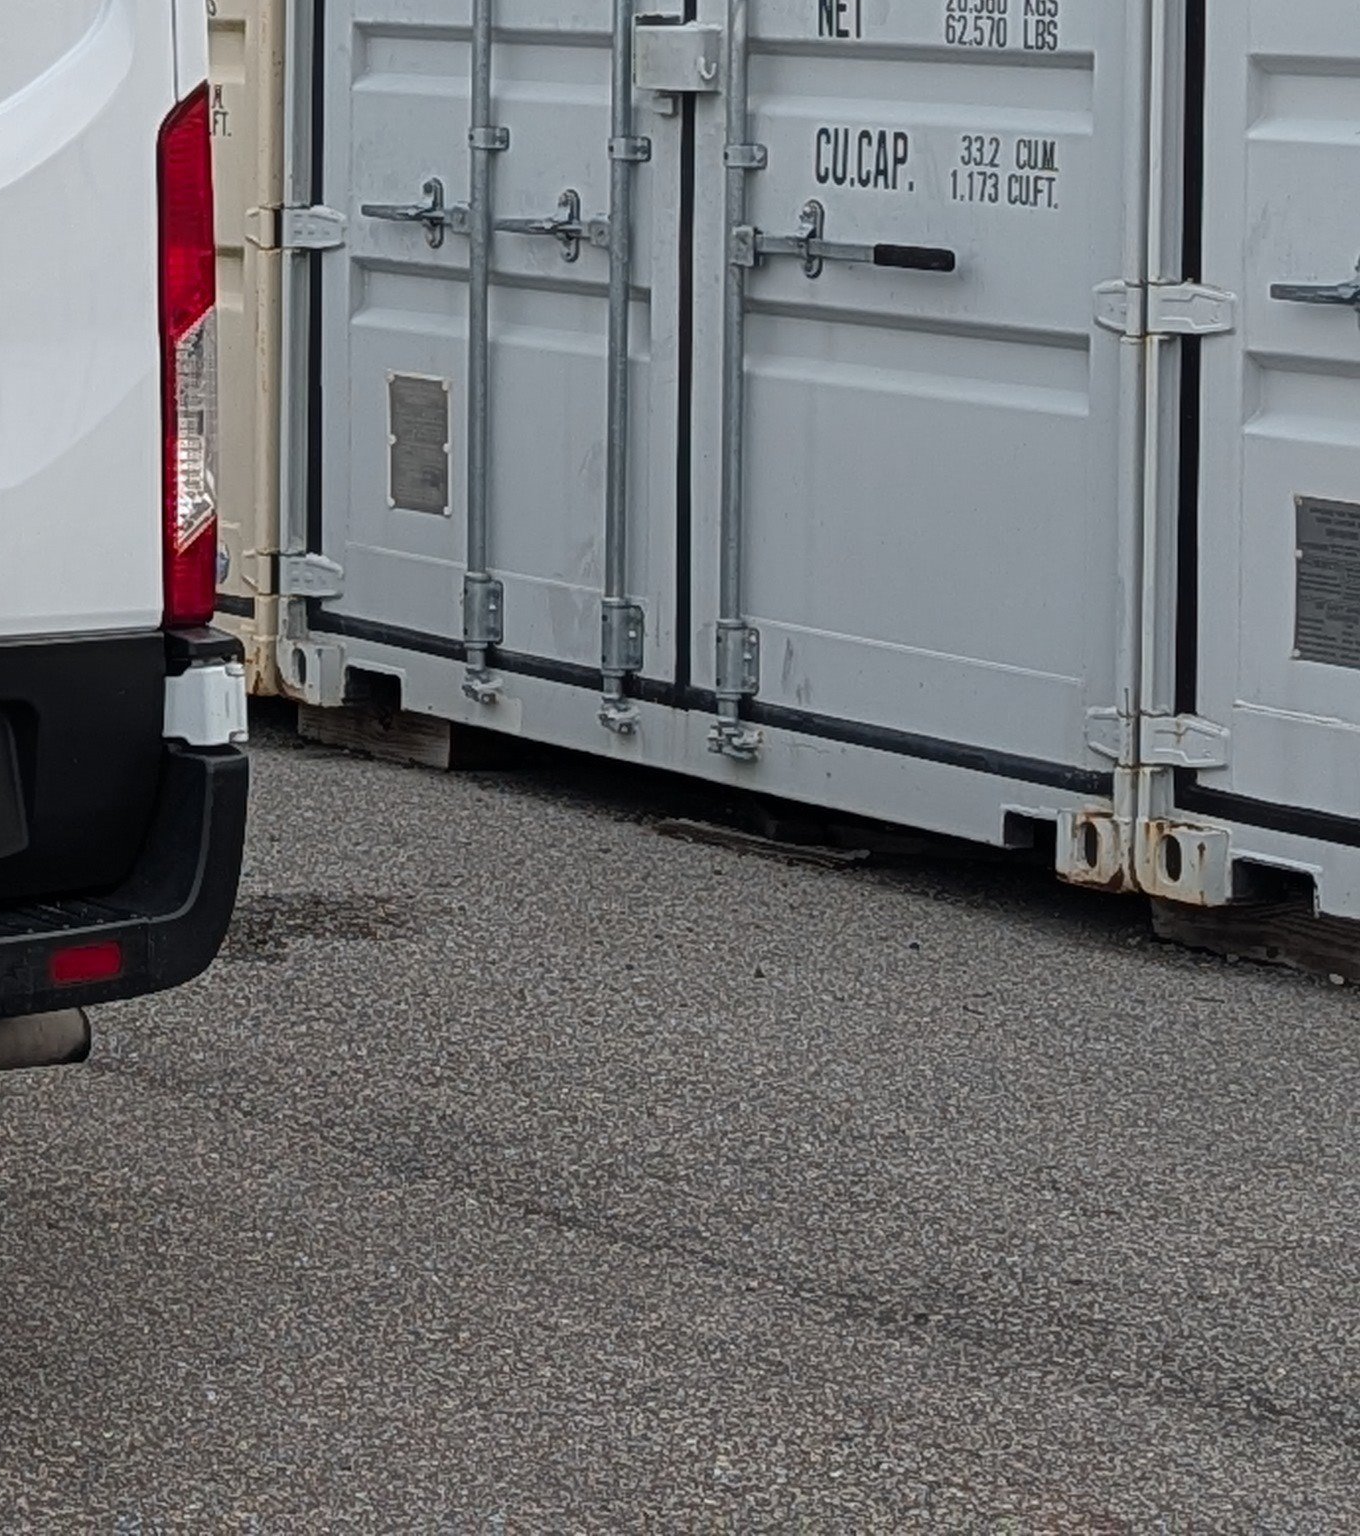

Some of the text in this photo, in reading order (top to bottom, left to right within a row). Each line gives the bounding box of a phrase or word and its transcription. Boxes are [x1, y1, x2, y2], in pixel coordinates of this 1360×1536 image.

[945, 14, 1058, 51] 62.570 LBS
[815, 127, 914, 192] CU.CAP.
[950, 169, 999, 203] 1.173
